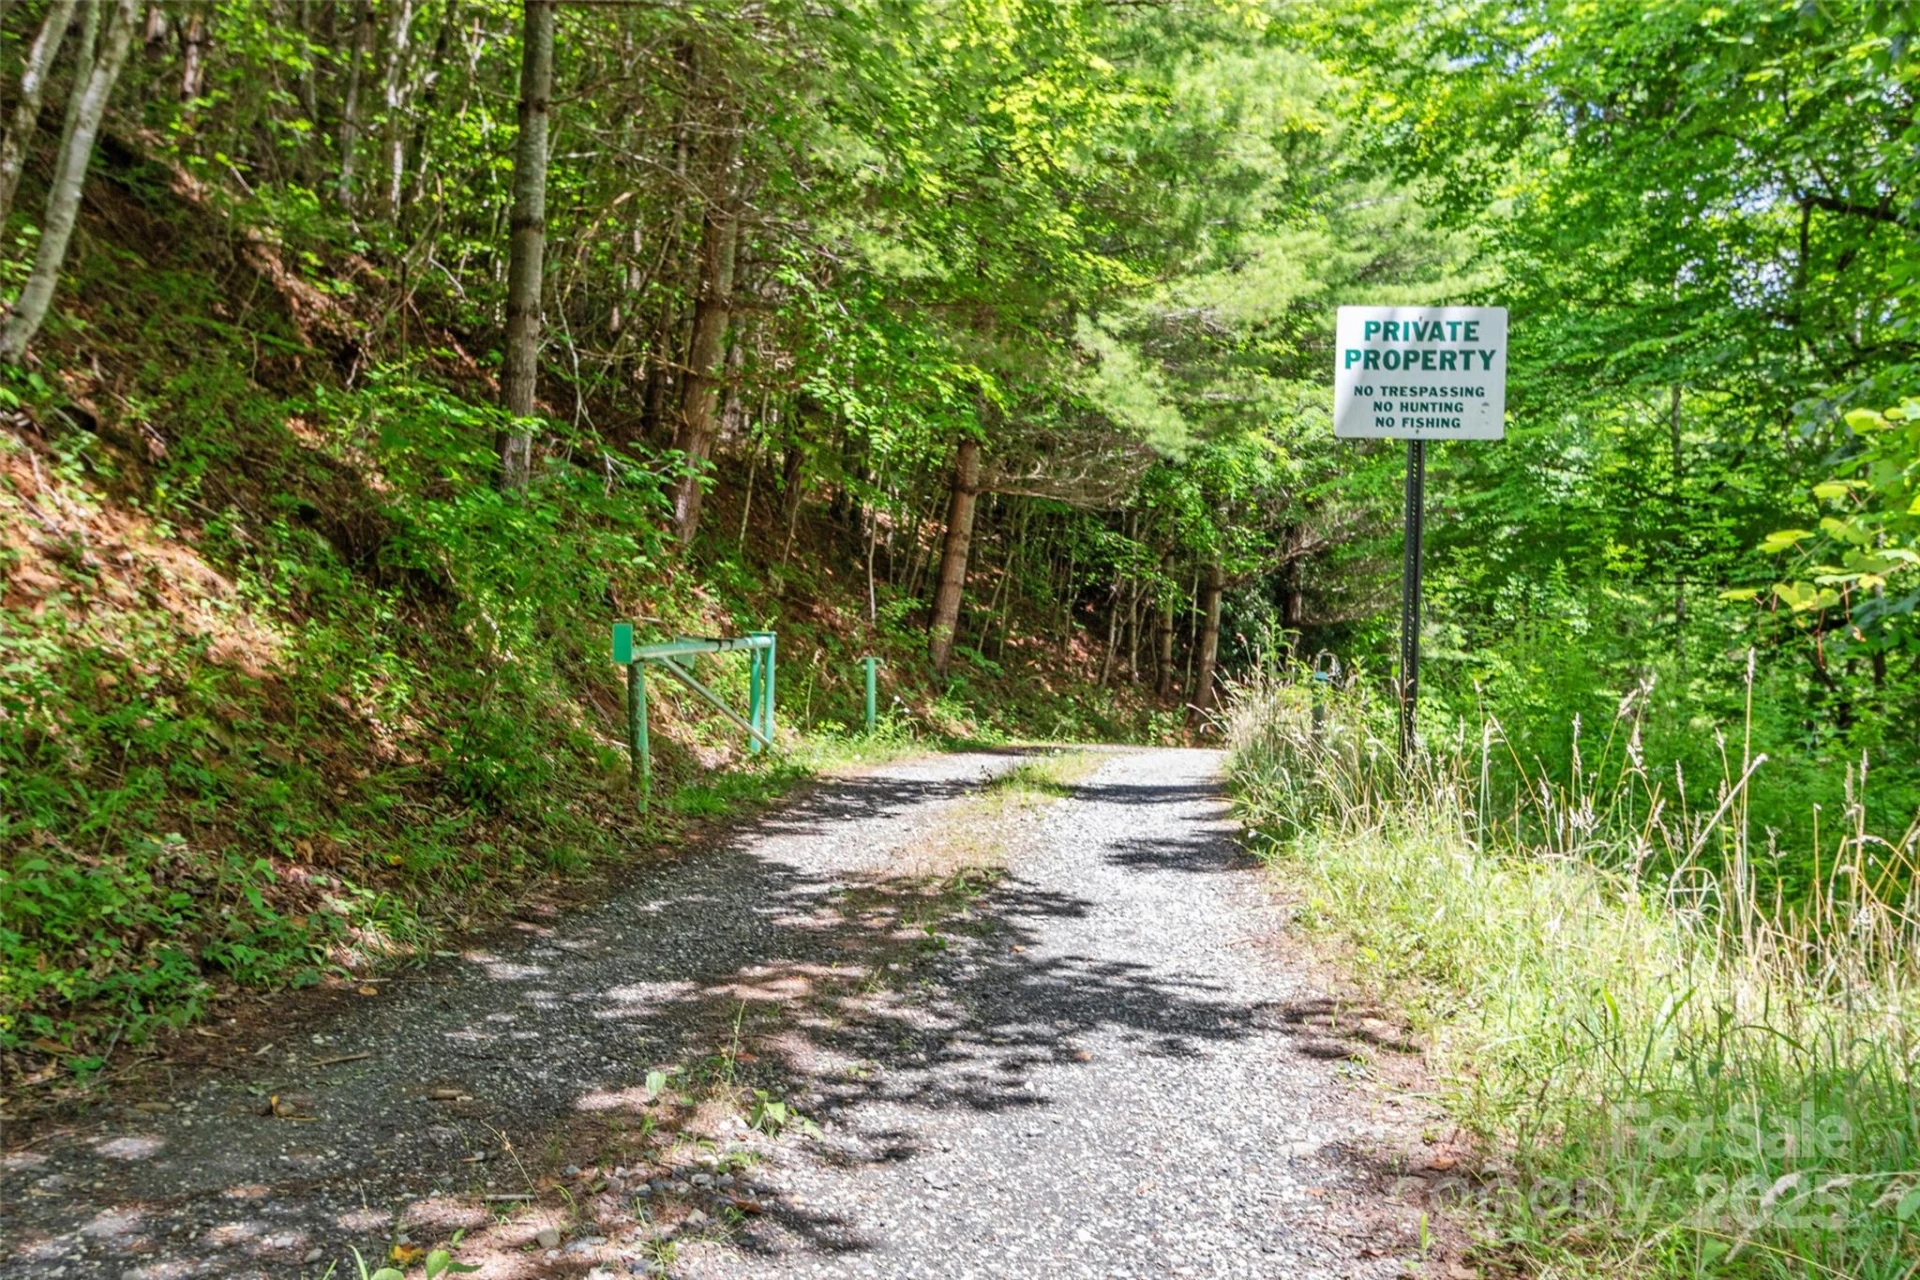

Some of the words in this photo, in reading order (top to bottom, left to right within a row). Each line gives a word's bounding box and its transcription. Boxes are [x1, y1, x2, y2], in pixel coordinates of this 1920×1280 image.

[1364, 320, 1480, 342] PRIVATE
[1345, 348, 1497, 371] PROPERTY
[1354, 385, 1374, 397] NO
[1380, 385, 1485, 398] TRESPASSING
[1373, 401, 1393, 412] NO
[1399, 401, 1464, 413] HUNTING
[1375, 417, 1395, 428] NO
[1402, 417, 1461, 429] FISHING
